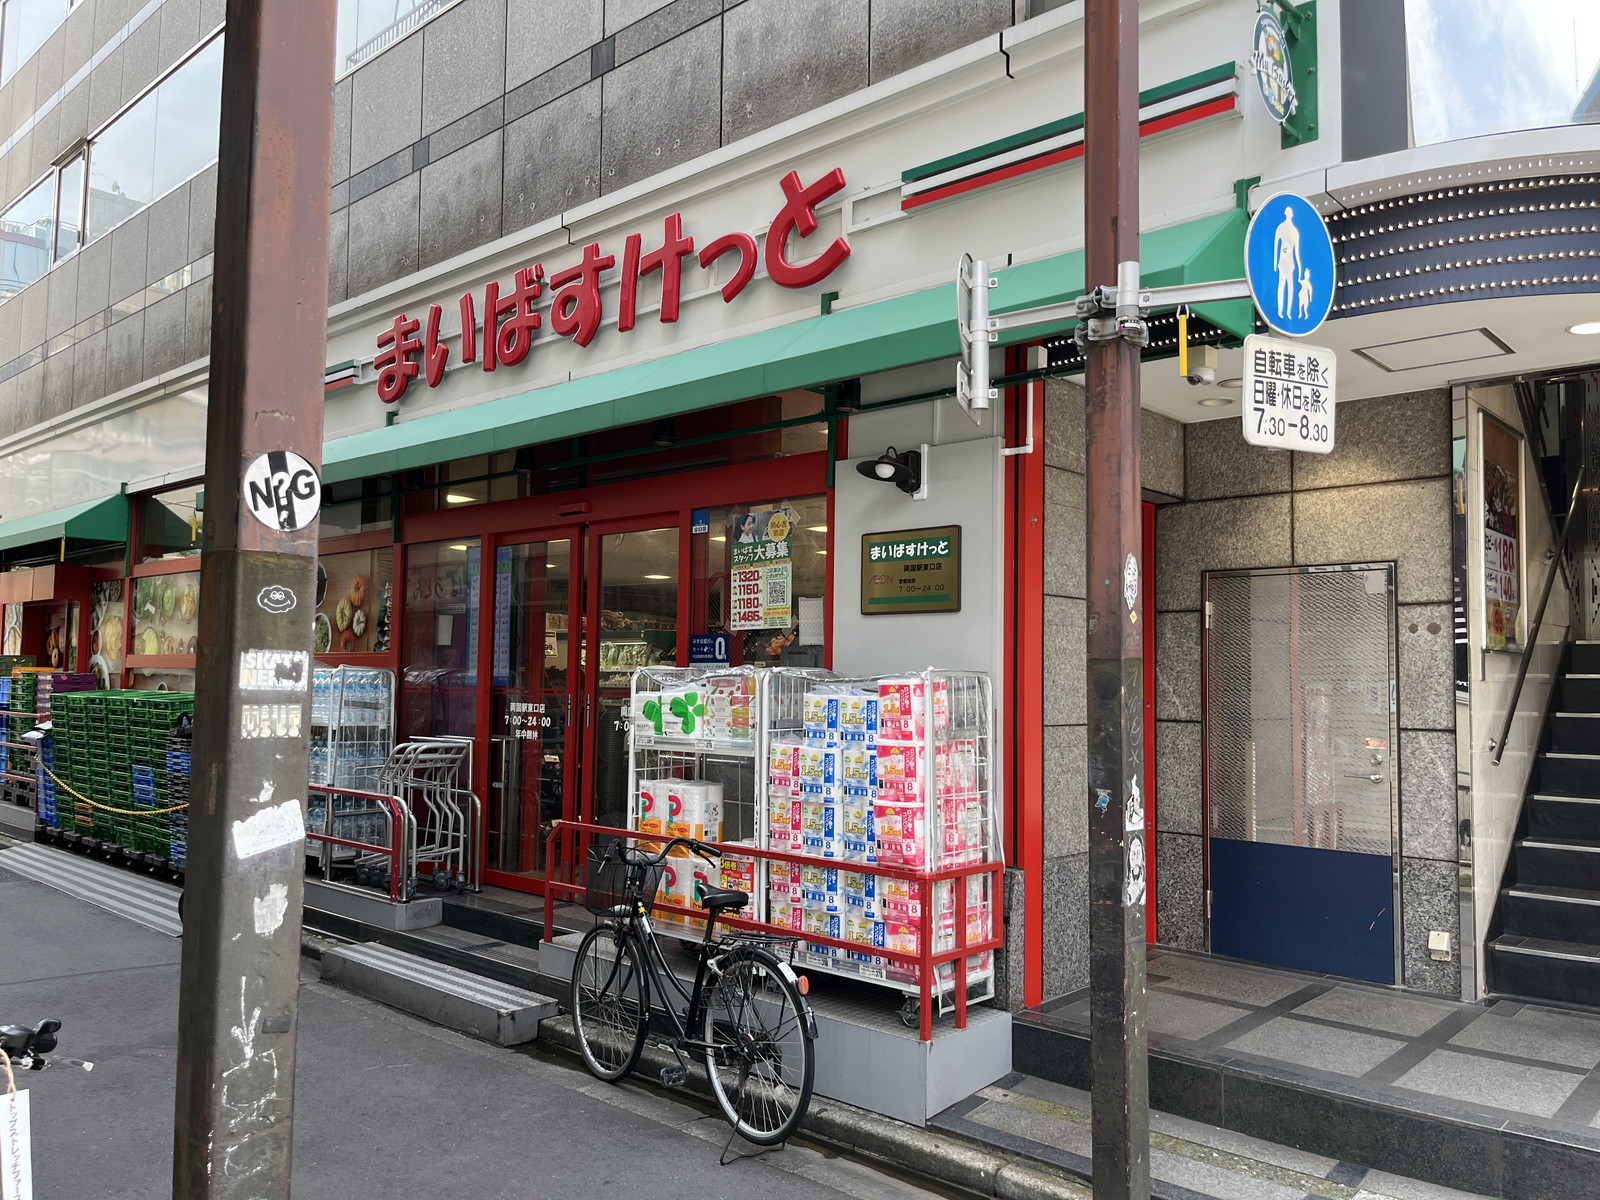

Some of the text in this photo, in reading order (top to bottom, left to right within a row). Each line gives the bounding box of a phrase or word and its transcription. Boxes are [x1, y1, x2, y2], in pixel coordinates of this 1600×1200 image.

[373, 166, 851, 404] まいばすけっと
[1254, 348, 1328, 384] 自転車を除く
[754, 541, 789, 561] 大募集
[870, 540, 949, 560] まいばすけっと
[509, 702, 546, 714] 両国駅東口店
[904, 720, 908, 728] 8
[515, 729, 539, 740] 年中無休
[828, 732, 834, 740] 8
[871, 790, 876, 798] 8
[793, 834, 798, 842] 8
[869, 846, 874, 854] 8
[906, 844, 912, 852] 8
[829, 896, 834, 904] 8
[911, 905, 917, 913] 8
